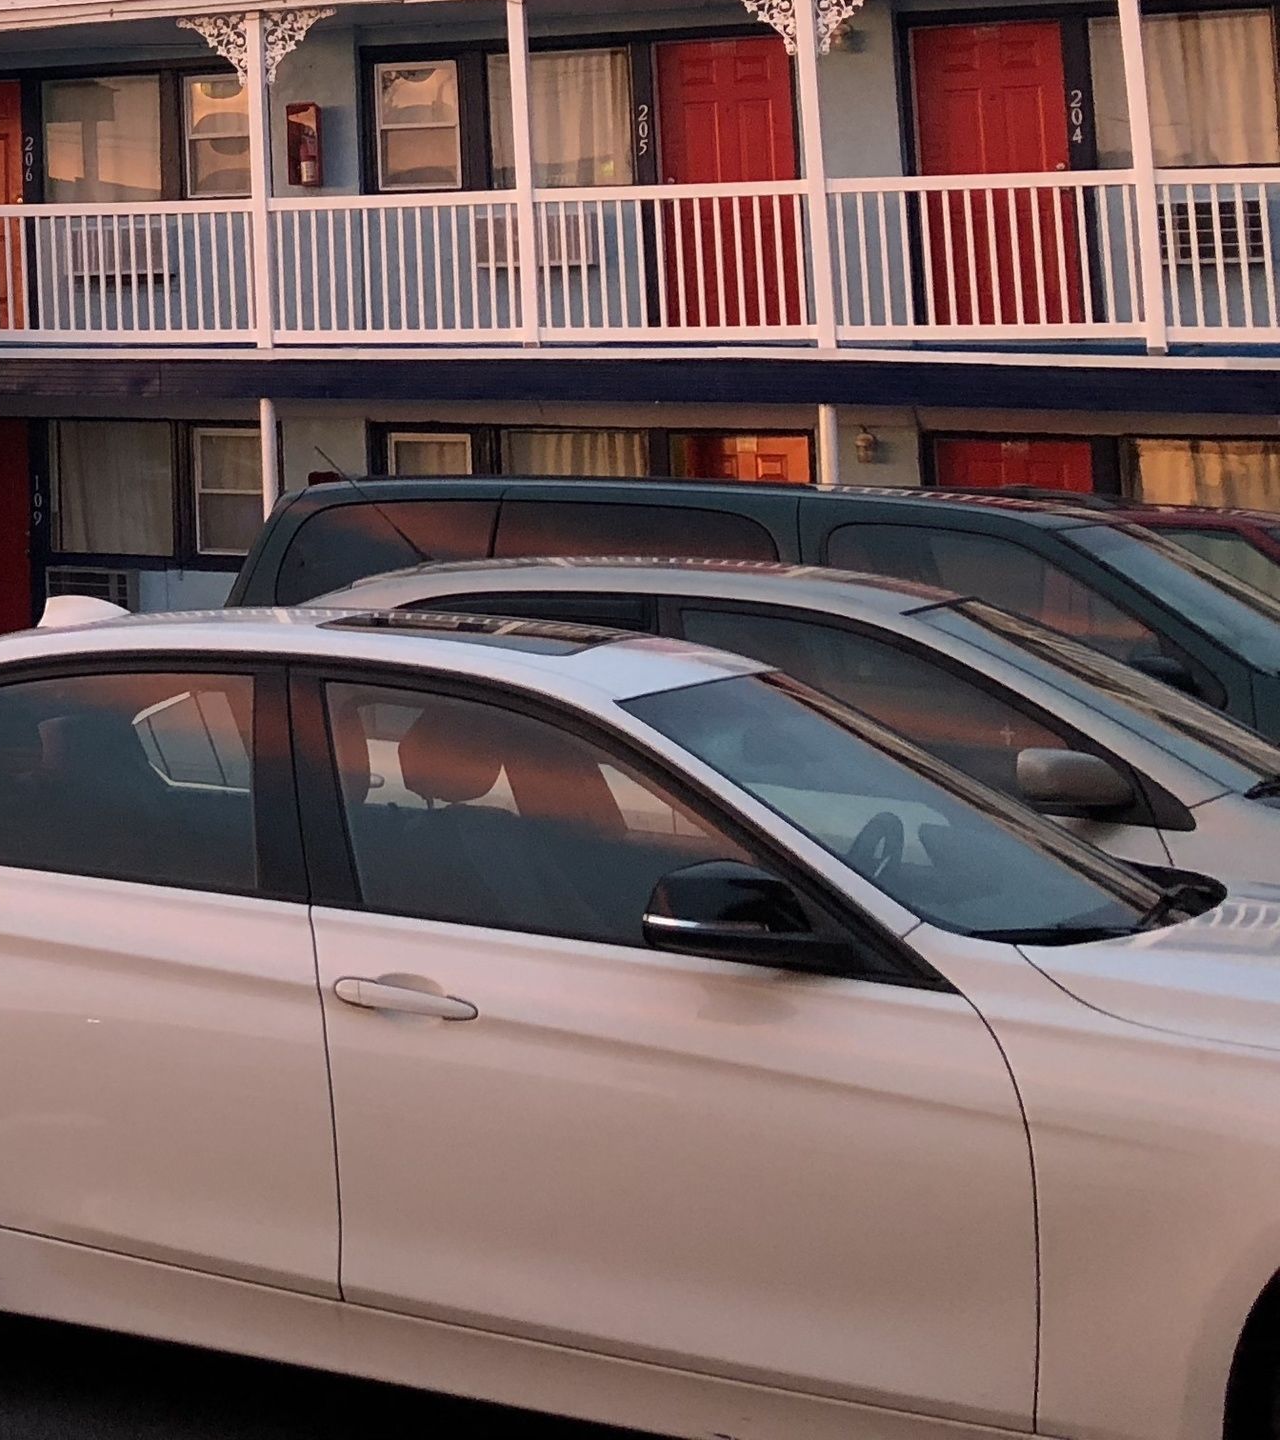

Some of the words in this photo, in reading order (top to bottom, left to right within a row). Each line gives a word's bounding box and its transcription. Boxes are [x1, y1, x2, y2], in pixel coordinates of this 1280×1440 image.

[637, 104, 649, 156] 205
[1069, 89, 1084, 144] 204
[24, 136, 34, 182] 206
[33, 474, 42, 526] 109
